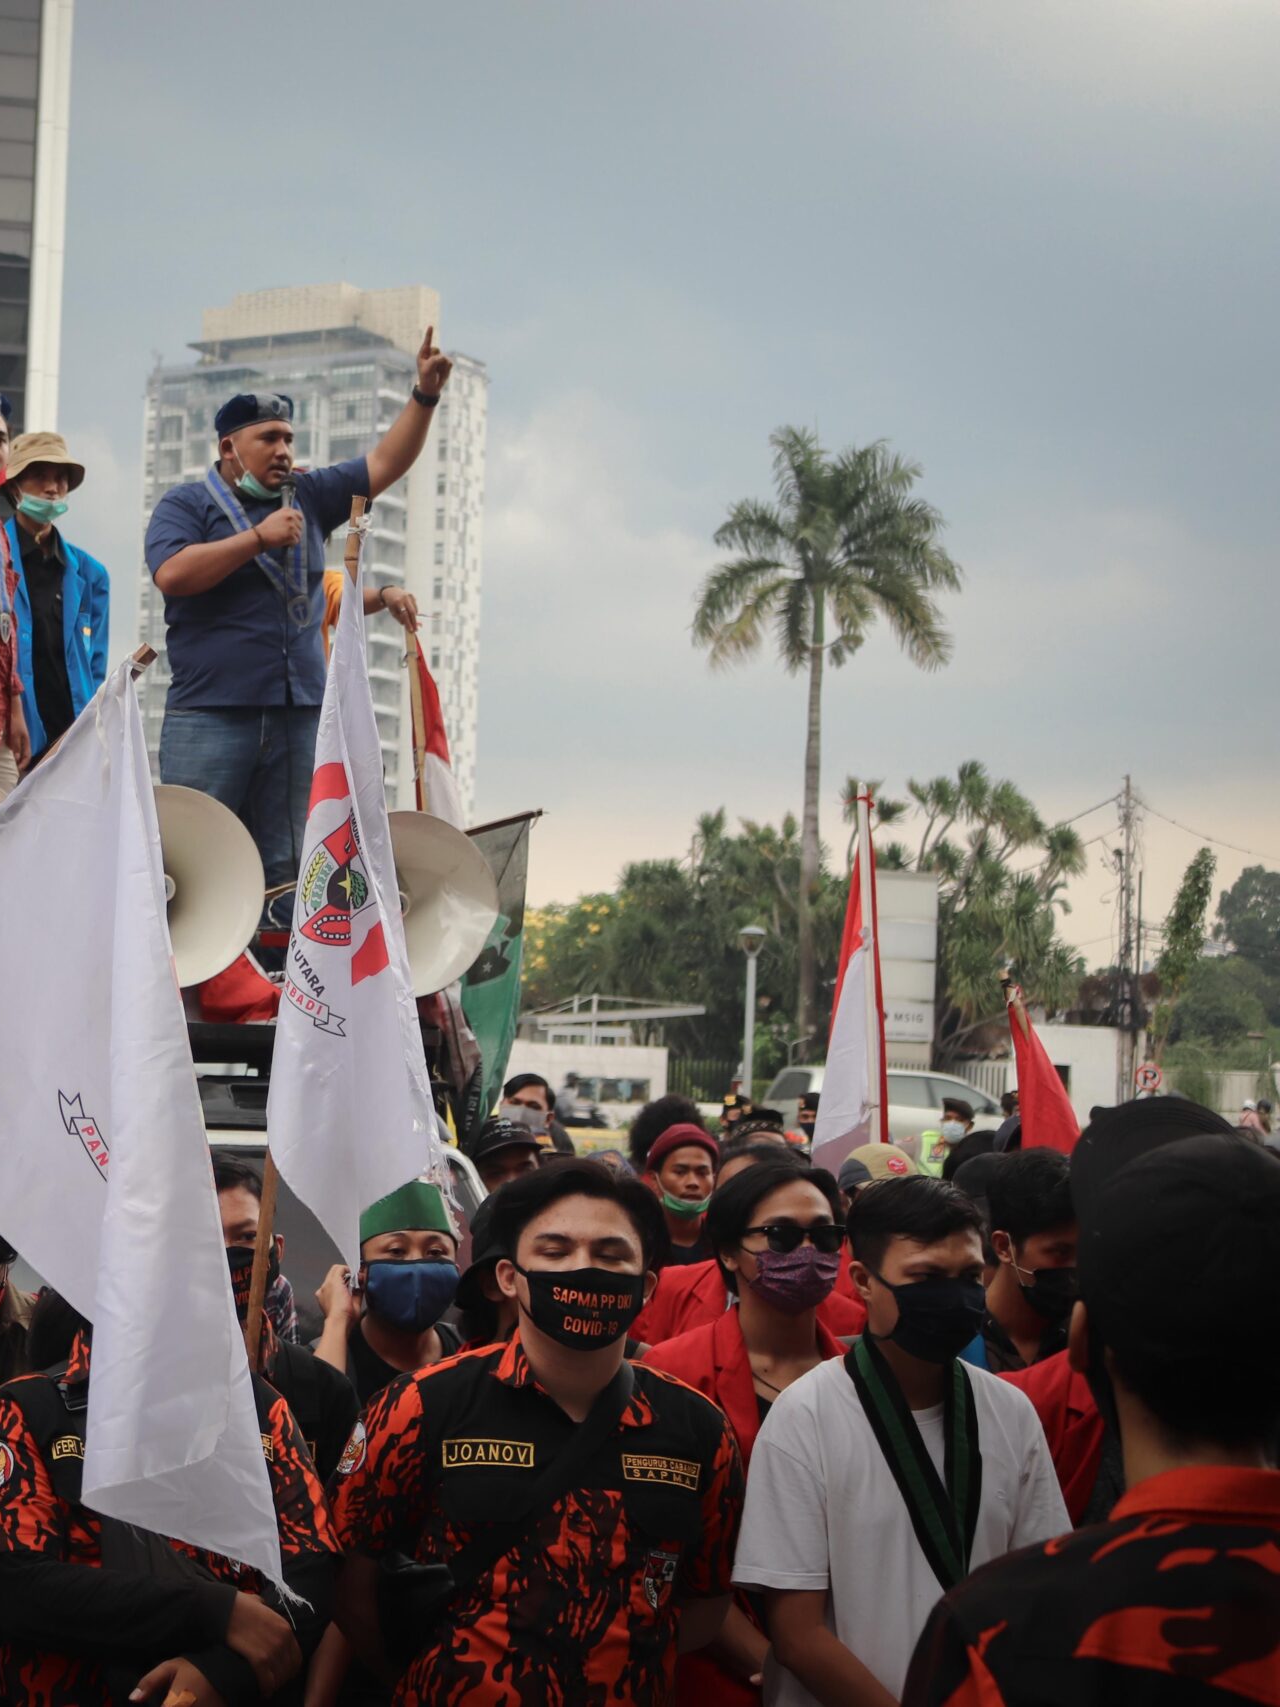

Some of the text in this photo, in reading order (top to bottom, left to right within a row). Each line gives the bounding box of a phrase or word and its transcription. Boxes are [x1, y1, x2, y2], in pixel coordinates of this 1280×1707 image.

[294, 950, 325, 998] UTARA
[285, 980, 324, 1015] ABADI
[894, 1012, 924, 1023] MSIG
[553, 1286, 632, 1309] SAPMA PP DKI
[563, 1316, 618, 1336] COVID-19
[56, 1439, 77, 1455] FERI
[449, 1444, 528, 1464] JOANOV
[627, 1457, 667, 1469] PENGURUS
[634, 1468, 691, 1486] SAPMA
